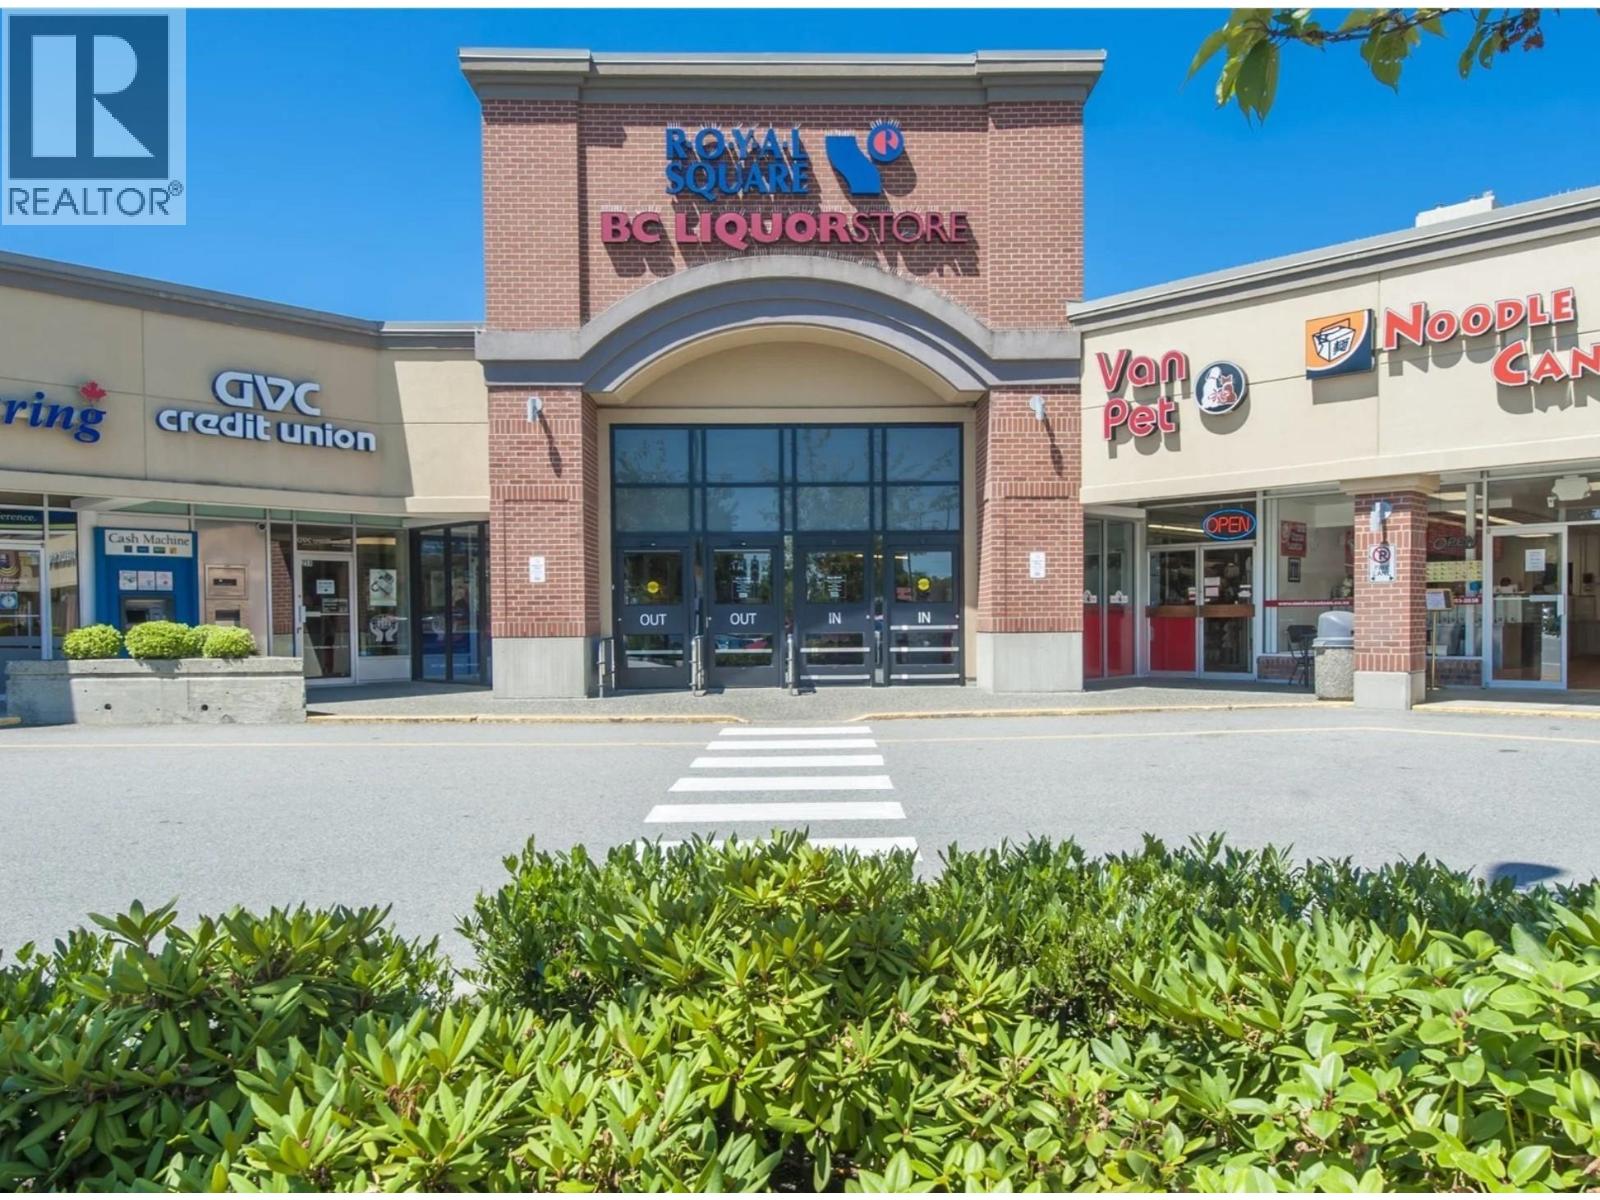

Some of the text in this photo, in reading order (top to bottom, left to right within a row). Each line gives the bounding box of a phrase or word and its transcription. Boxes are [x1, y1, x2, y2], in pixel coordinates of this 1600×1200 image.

[665, 160, 808, 202] SQUARE
[601, 212, 661, 243] BC
[1383, 287, 1575, 351] NOODLE
[1096, 349, 1187, 392] Van
[4, 391, 107, 443] ring
[156, 409, 377, 452] credit union
[1103, 397, 1177, 441] Pet
[108, 532, 190, 546] Cash Machine
[1206, 516, 1250, 533] OPEN
[640, 614, 668, 626] OUT
[730, 612, 757, 625] OUT
[828, 612, 842, 625] IN
[917, 611, 931, 625] IN
